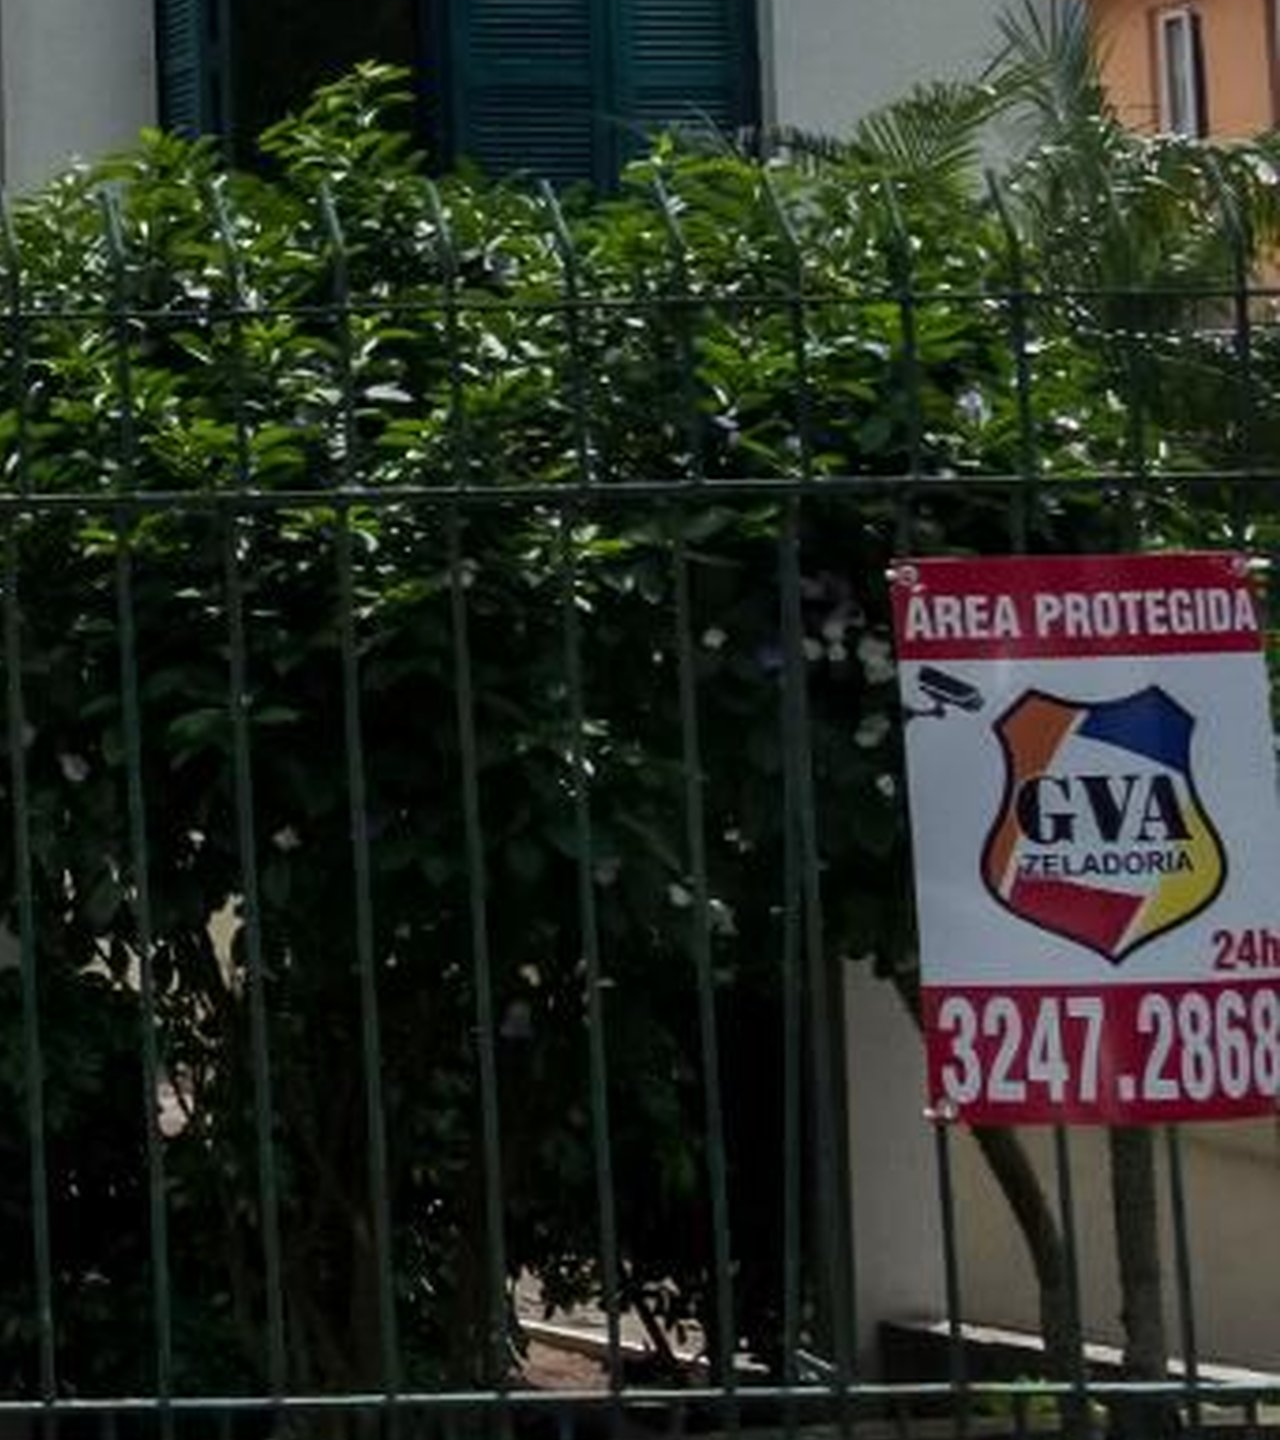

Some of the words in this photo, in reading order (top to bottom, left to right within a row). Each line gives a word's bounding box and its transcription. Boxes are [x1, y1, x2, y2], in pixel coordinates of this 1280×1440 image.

[1036, 588, 1258, 638] PROTEGIDA
[1016, 773, 1194, 844] GVA
[1021, 850, 1195, 875] ZELADORIA
[941, 988, 1280, 1103] 3247.2868
